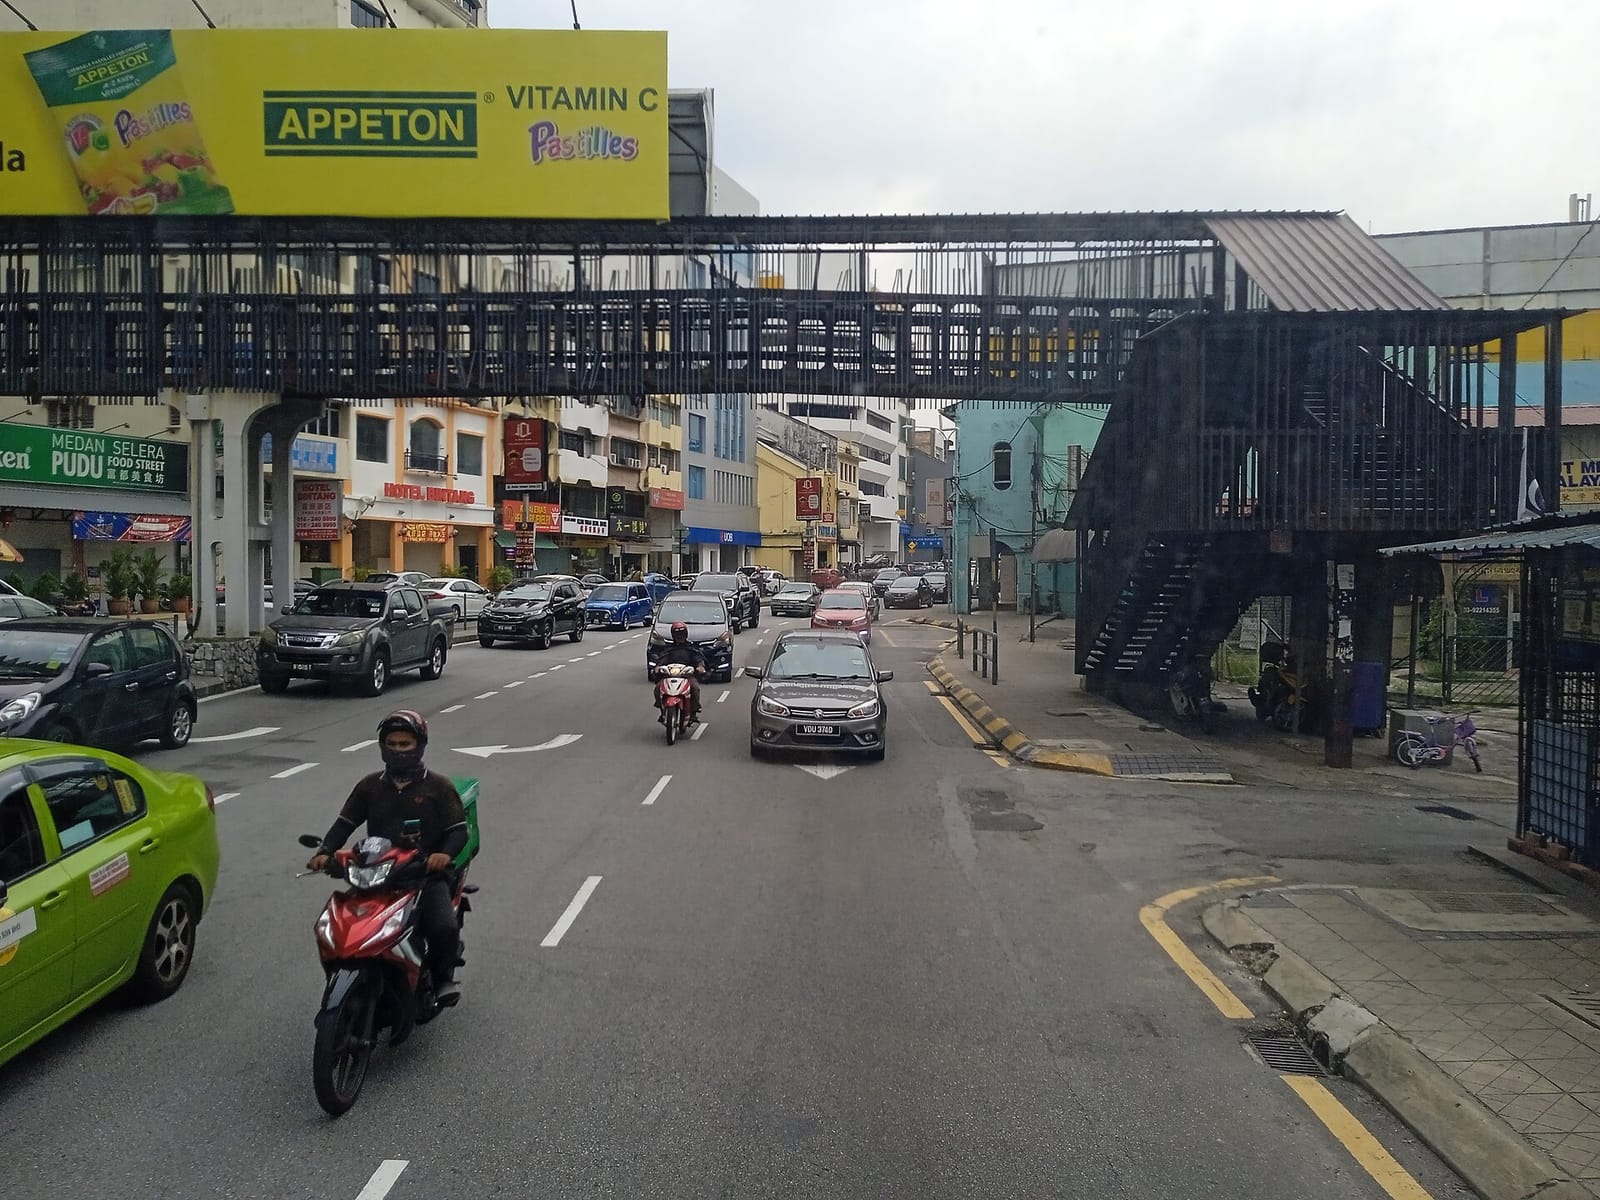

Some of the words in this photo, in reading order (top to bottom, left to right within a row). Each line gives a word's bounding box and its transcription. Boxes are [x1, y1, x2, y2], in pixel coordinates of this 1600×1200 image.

[77, 52, 149, 86] APPETON
[507, 85, 628, 111] VITAMIN
[638, 87, 659, 112] C
[114, 102, 193, 149] Pastilles
[278, 108, 464, 141] APPETON
[528, 121, 639, 165] Pastilles
[52, 433, 105, 453] MEDAN
[113, 441, 165, 460] SELERA
[0, 452, 31, 470] en
[52, 451, 104, 479] PUDU
[107, 456, 134, 469] FOOD
[136, 459, 165, 472] STREET
[384, 483, 425, 500] HOTEL
[426, 486, 475, 505] BINTANG
[723, 532, 734, 542] UOB
[803, 725, 817, 733] VDU
